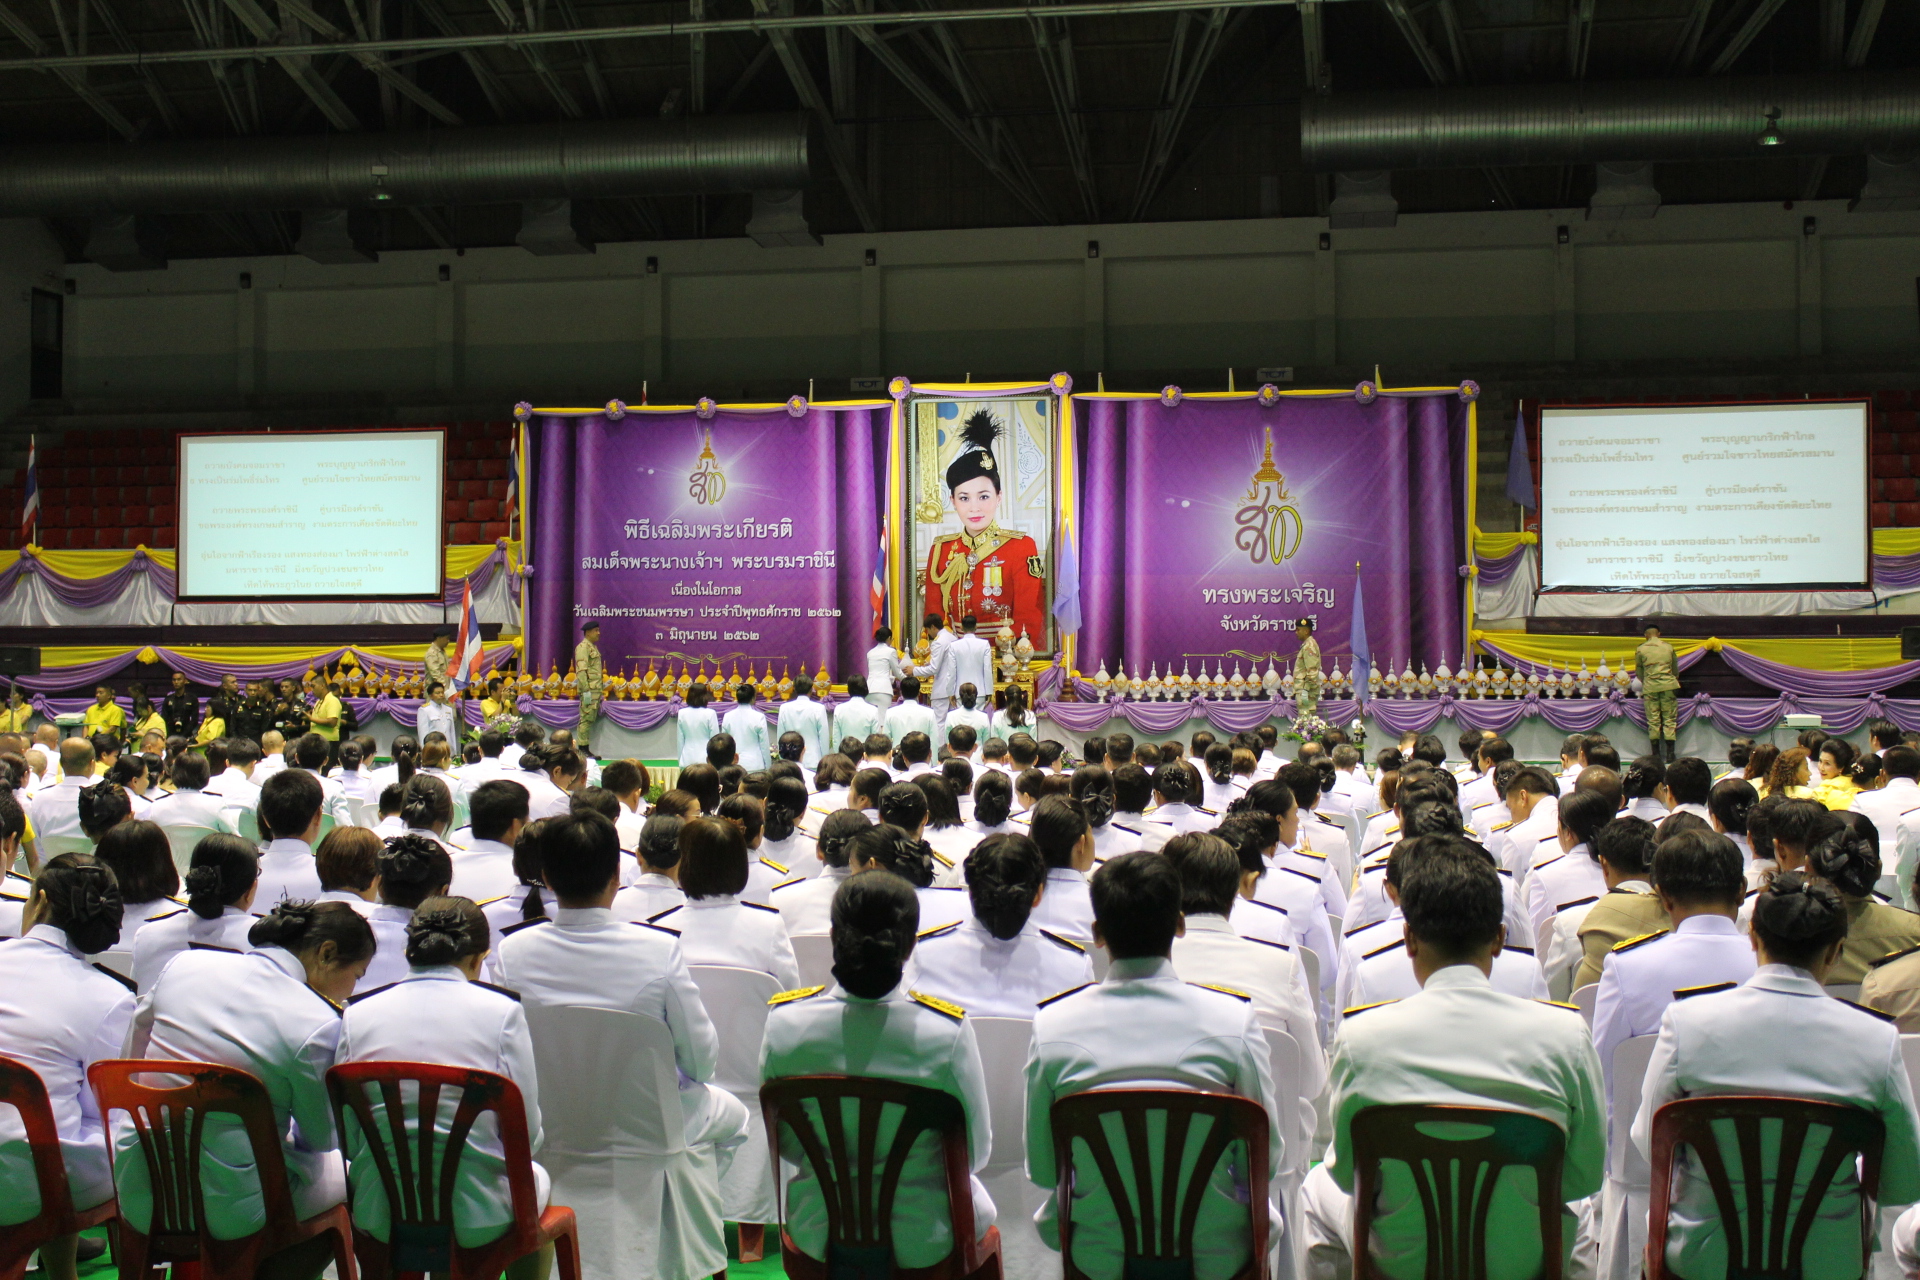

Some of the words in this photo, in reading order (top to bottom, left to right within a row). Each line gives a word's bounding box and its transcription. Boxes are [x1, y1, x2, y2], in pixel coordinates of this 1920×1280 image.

[624, 518, 794, 540] พิธีเฉลิมพระเกียรติ
[581, 550, 724, 571] สมเด็จพระนางเจ้าฯ
[732, 550, 836, 570] พระบรมราชินี
[670, 581, 743, 596] เนื่องในโอกาส
[1202, 582, 1336, 609] ทรงพระเจริญ
[573, 604, 694, 618] วันเฉลิมพระชนมพรรษา
[700, 604, 802, 622] ประจำปีพุทธศักราช
[806, 607, 842, 617] ๒๕๖๒
[1220, 614, 1318, 632] จังหวัดราชรี
[655, 632, 664, 640] ๓
[670, 626, 717, 644] มิถุนายน
[723, 630, 760, 641] ๒๕๖๒
